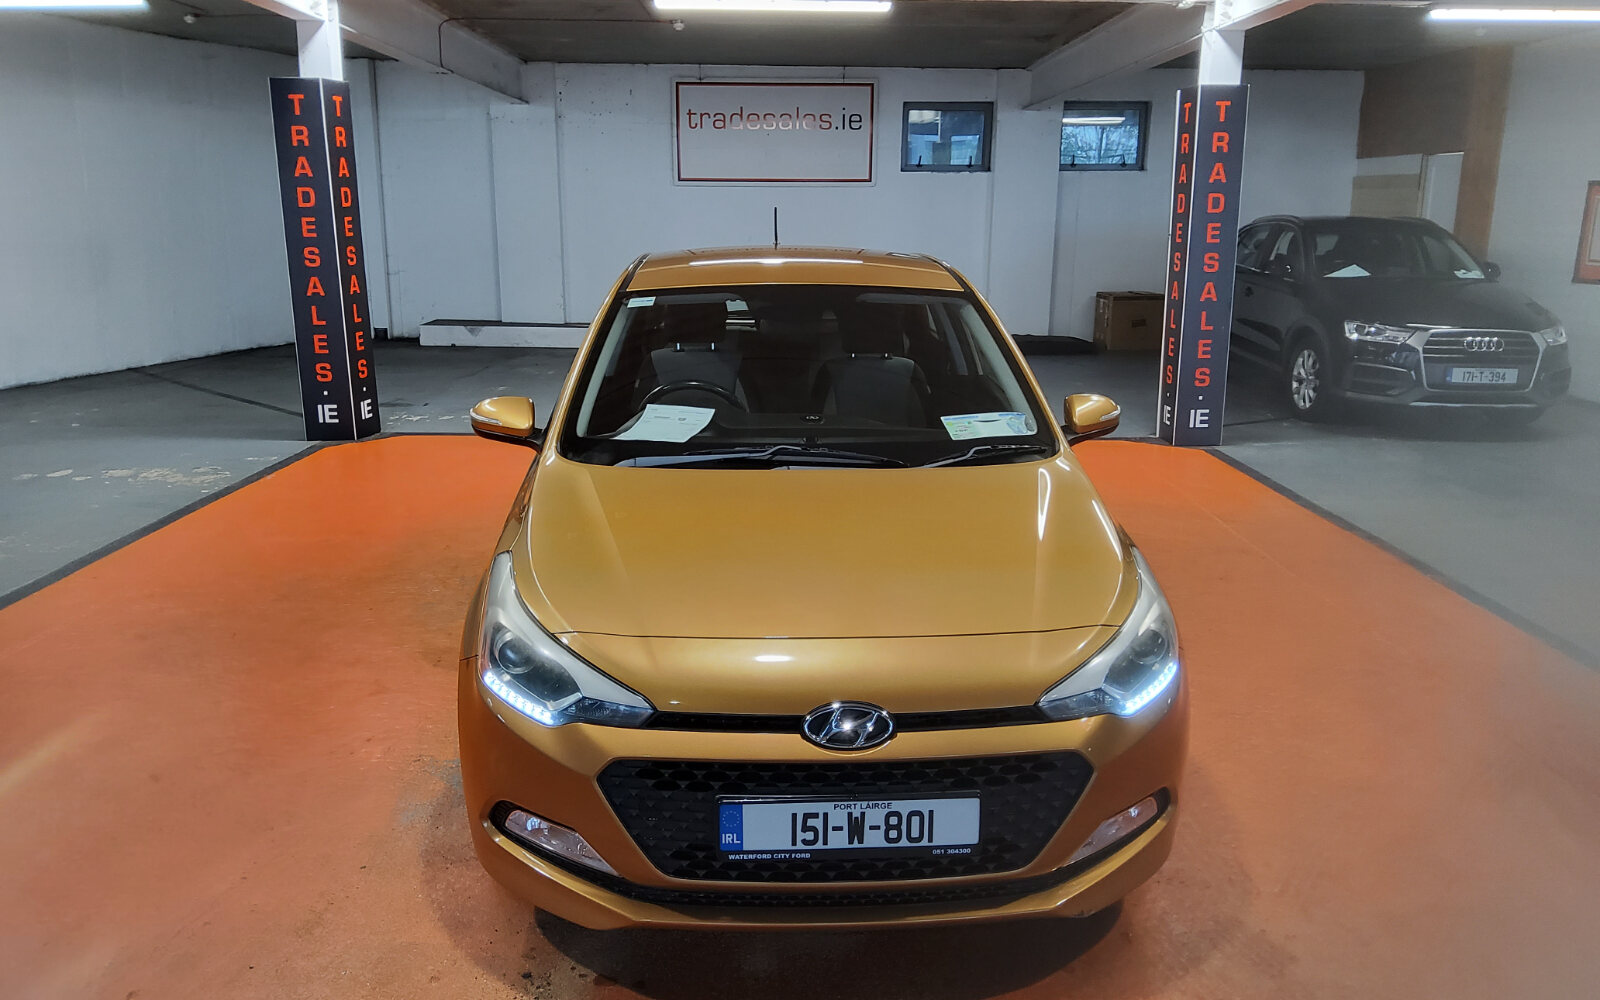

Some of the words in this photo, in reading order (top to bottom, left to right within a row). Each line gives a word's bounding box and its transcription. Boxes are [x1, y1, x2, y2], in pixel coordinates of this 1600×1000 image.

[686, 106, 863, 131] tradesales.ie
[1462, 371, 1507, 383] 171-T-394
[833, 803, 858, 811] PORT
[860, 801, 893, 810] LÁIRGE
[791, 809, 934, 847] 151-W-801
[721, 833, 741, 844] IRL
